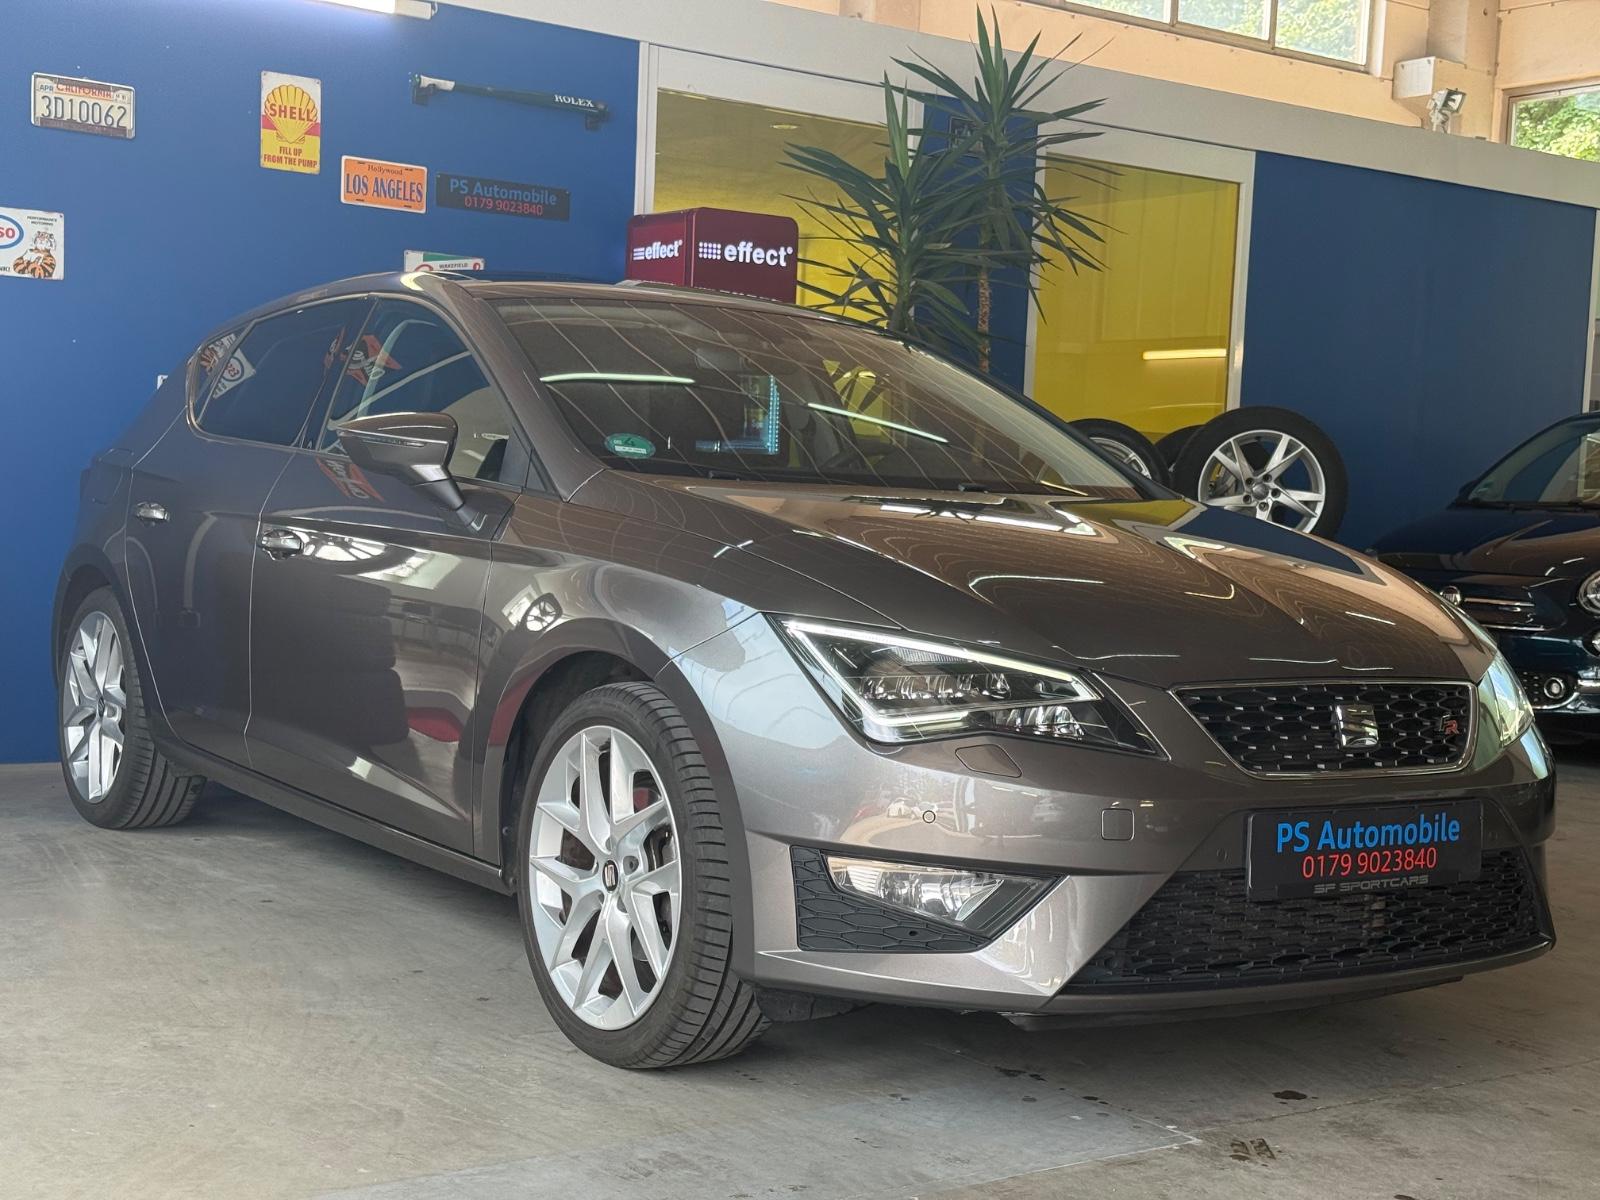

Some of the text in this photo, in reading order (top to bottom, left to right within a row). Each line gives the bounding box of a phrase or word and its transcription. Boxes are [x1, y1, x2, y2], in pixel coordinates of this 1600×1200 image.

[40, 84, 54, 92] APR
[553, 94, 595, 108] ROLEX
[41, 95, 127, 128] 3D10062
[269, 103, 314, 122] SHELL
[263, 154, 318, 168] FROM THE PUMP
[279, 146, 303, 156] FILL UP
[367, 165, 403, 176] Hollywood
[346, 173, 424, 203] LOS ANGELES
[449, 178, 557, 205] PS Automobile
[464, 195, 544, 216] 0179 9023840
[1277, 812, 1461, 852] PS Automobile
[1302, 847, 1437, 878] 0179 9023840
[1314, 874, 1429, 894] SF SPORTCARS
